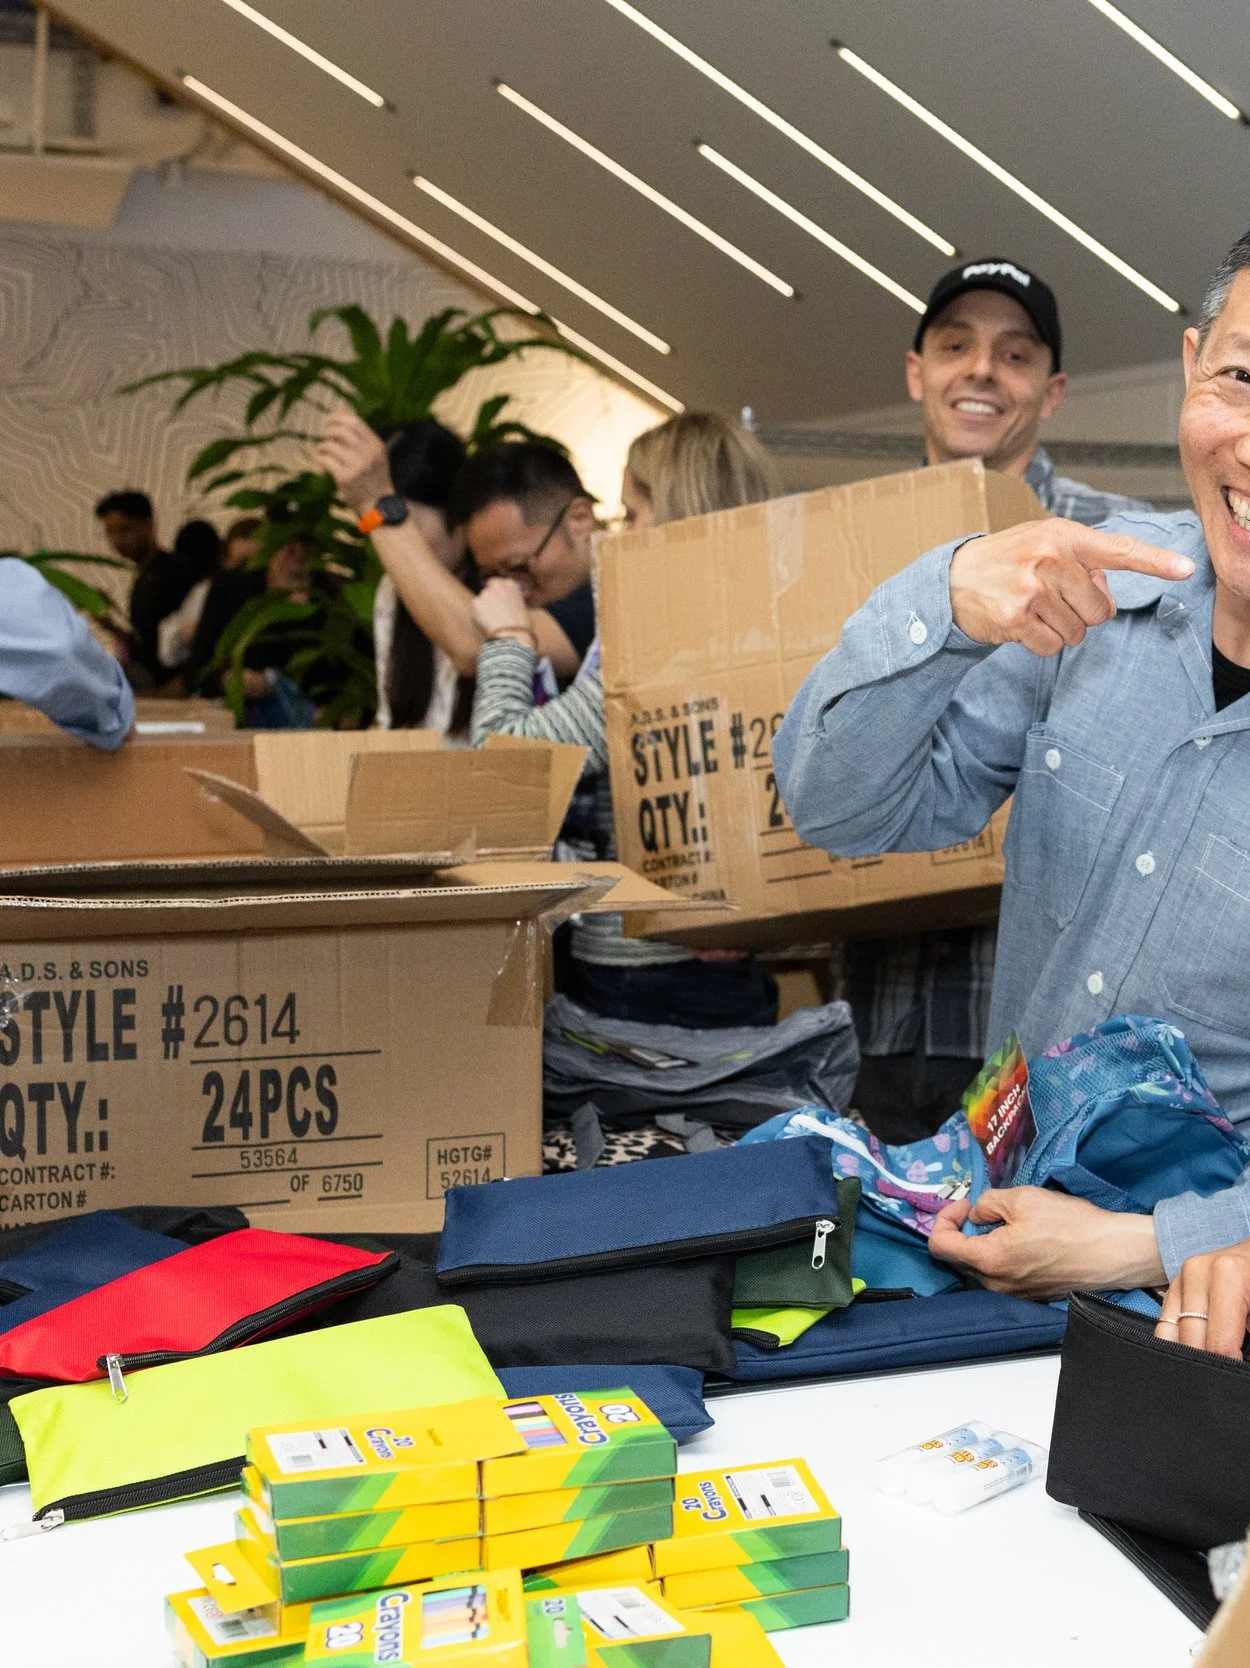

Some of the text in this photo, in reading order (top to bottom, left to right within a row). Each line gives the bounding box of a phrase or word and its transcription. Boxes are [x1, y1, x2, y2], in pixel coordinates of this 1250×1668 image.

[631, 719, 719, 787] STYLE
[70, 961, 83, 979] &
[89, 959, 149, 979] SONS
[0, 988, 138, 1067] STYLE
[0, 1064, 339, 1163] QTY.: 24PCS
[987, 1083, 1021, 1132] 17 INCH
[0, 1162, 97, 1186] CONTRACT
[239, 1147, 298, 1169] 53564
[437, 1144, 493, 1166] HGTG#
[76, 1189, 87, 1208] #
[290, 1175, 309, 1192] OF
[322, 1172, 364, 1193] 6750
[441, 1166, 492, 1189] 52614
[554, 1392, 608, 1444] Crayons
[599, 1403, 641, 1423] 20
[366, 1428, 394, 1459] Crayons
[392, 1436, 414, 1447] 20
[682, 1497, 702, 1511] 20
[699, 1481, 727, 1520] Crayons
[325, 1621, 364, 1649] 20
[378, 1592, 409, 1661] Crayons
